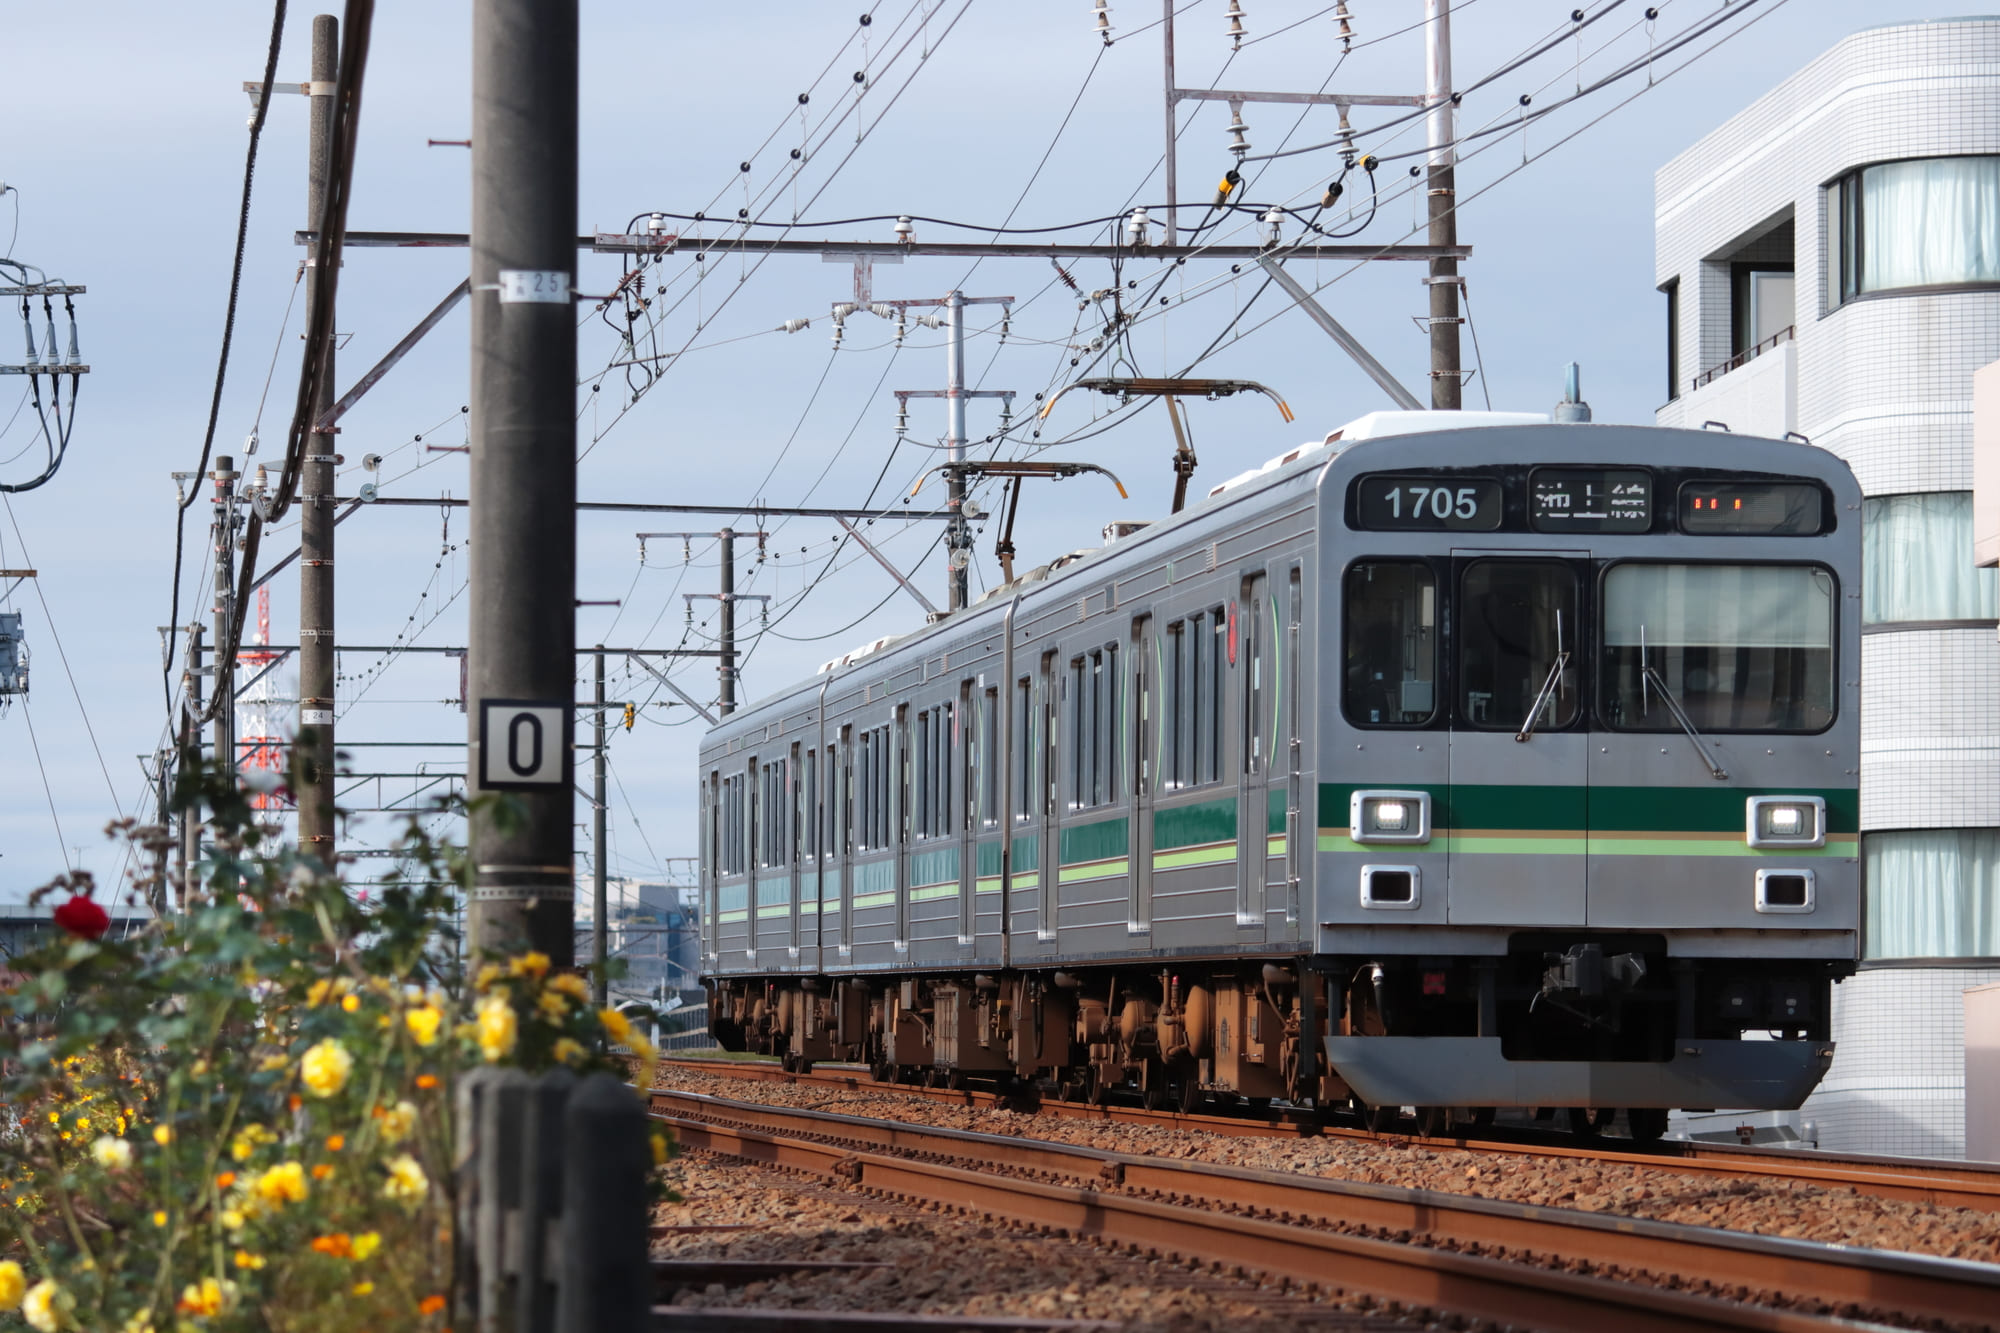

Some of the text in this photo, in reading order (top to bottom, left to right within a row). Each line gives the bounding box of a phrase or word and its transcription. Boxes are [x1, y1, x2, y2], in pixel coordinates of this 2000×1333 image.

[533, 272, 558, 293] 25
[1384, 487, 1477, 519] 1705
[312, 711, 324, 720] 24
[508, 712, 543, 777] 0
